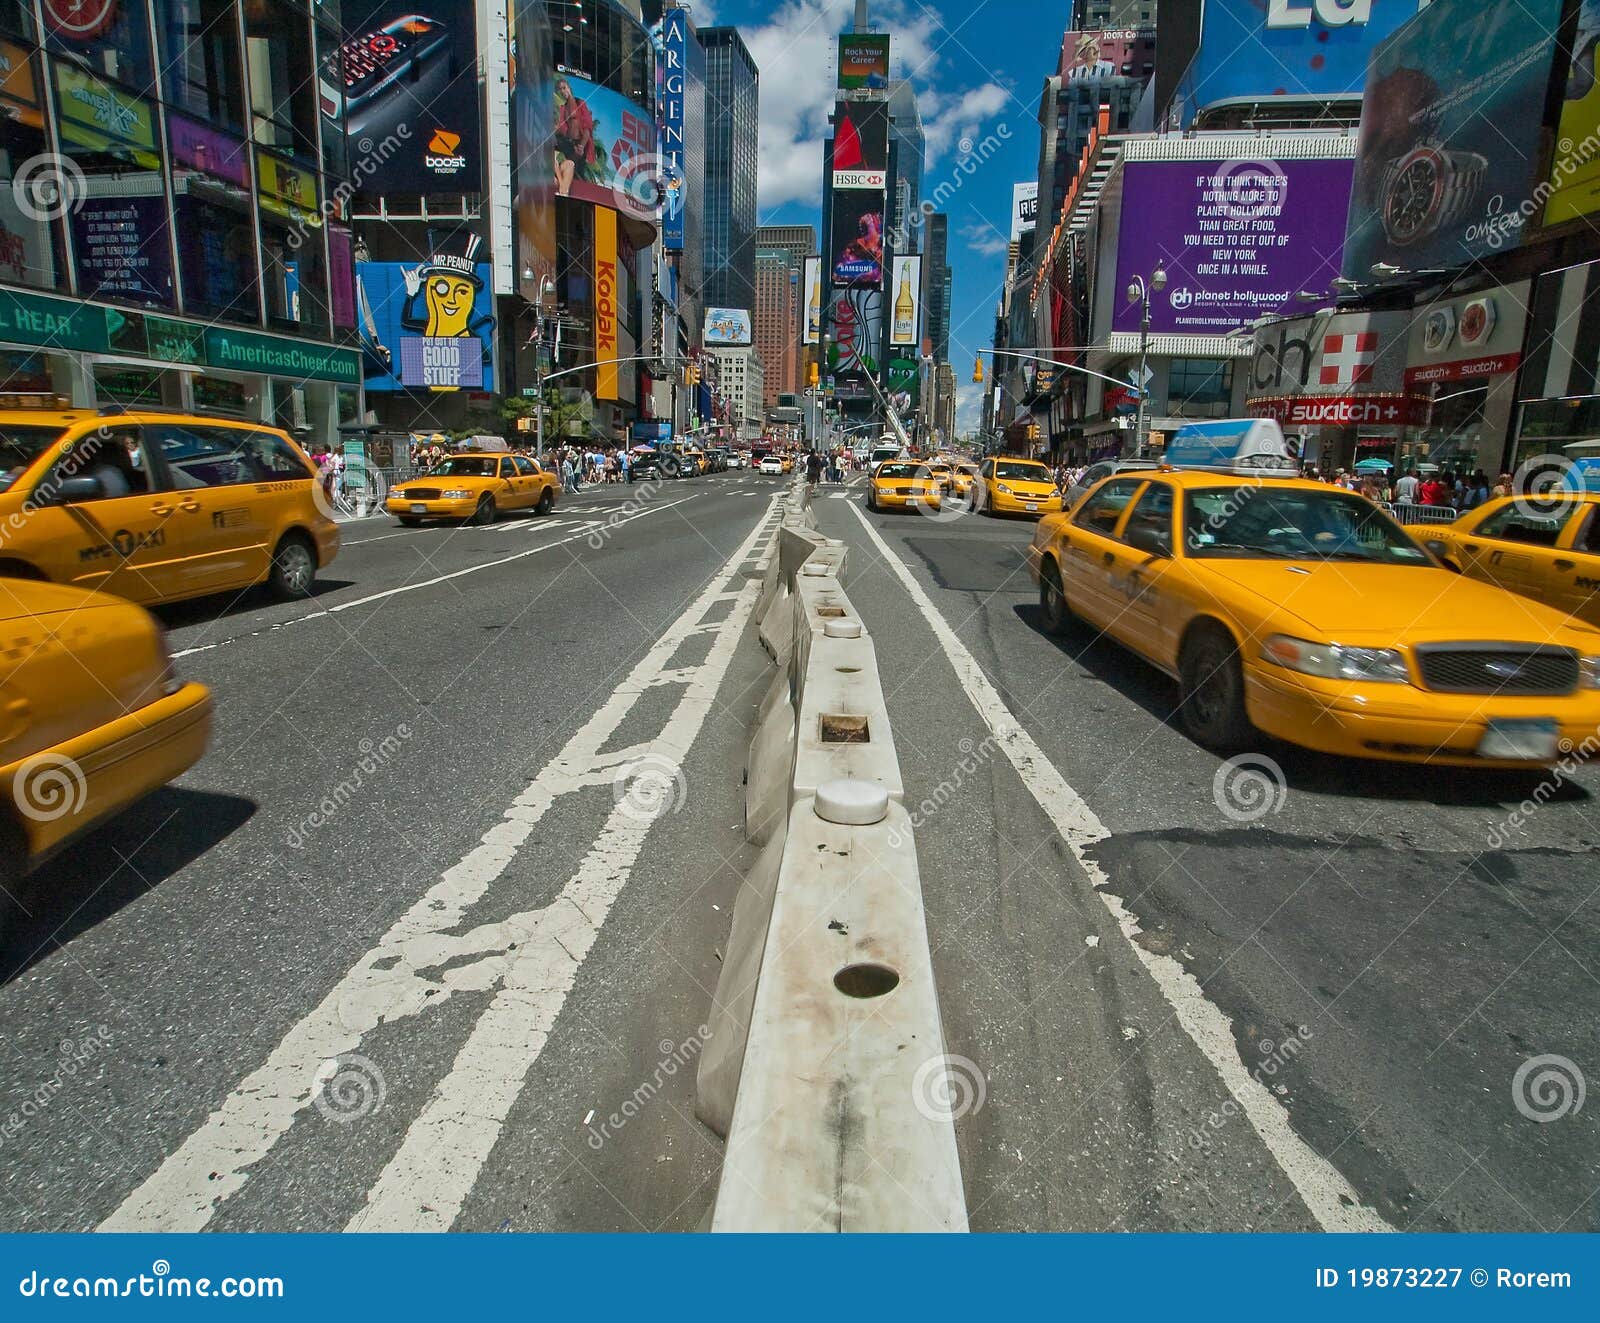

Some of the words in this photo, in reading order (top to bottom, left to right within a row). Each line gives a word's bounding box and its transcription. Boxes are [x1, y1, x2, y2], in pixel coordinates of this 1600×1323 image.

[844, 47, 863, 56] Rock
[865, 48, 884, 56] Your
[667, 20, 683, 169] ARGENT
[425, 155, 466, 168] boost
[835, 174, 866, 185] HSBC
[1196, 176, 1205, 187] IF
[1207, 176, 1224, 187] YOU
[1226, 176, 1251, 187] THINK
[1252, 175, 1288, 187] THERE'S
[1202, 190, 1239, 202] NOTHING
[1240, 190, 1265, 202] MORE
[1267, 190, 1279, 202] TO
[1197, 205, 1229, 217] PLANET
[1230, 205, 1281, 217] HOLLYWOOD
[1199, 220, 1221, 231] THAN
[1222, 220, 1250, 231] GREAT
[1251, 220, 1276, 233] FOOD,
[1465, 212, 1521, 242] OMEGA
[1184, 234, 1200, 246] YOU
[1202, 234, 1224, 246] NEED
[1227, 234, 1238, 246] TO
[1240, 234, 1257, 246] GET
[1258, 234, 1276, 246] OUT
[1277, 234, 1290, 246] OF
[1212, 249, 1232, 260] NEW
[1234, 249, 1257, 260] YORK
[433, 254, 447, 267] MR.
[447, 255, 475, 273] PEANUT
[840, 264, 873, 272] SAMSUNG
[1197, 263, 1219, 275] ONCE
[1221, 263, 1230, 275] IN
[1232, 263, 1238, 275] A
[1240, 263, 1269, 275] WHILE.
[1195, 290, 1231, 304] planet
[1233, 290, 1289, 303] hollywood
[597, 260, 616, 351] Kodak
[220, 338, 356, 376] AmericasCheer.com
[423, 346, 460, 367] GOOD
[423, 367, 461, 386] STUFF
